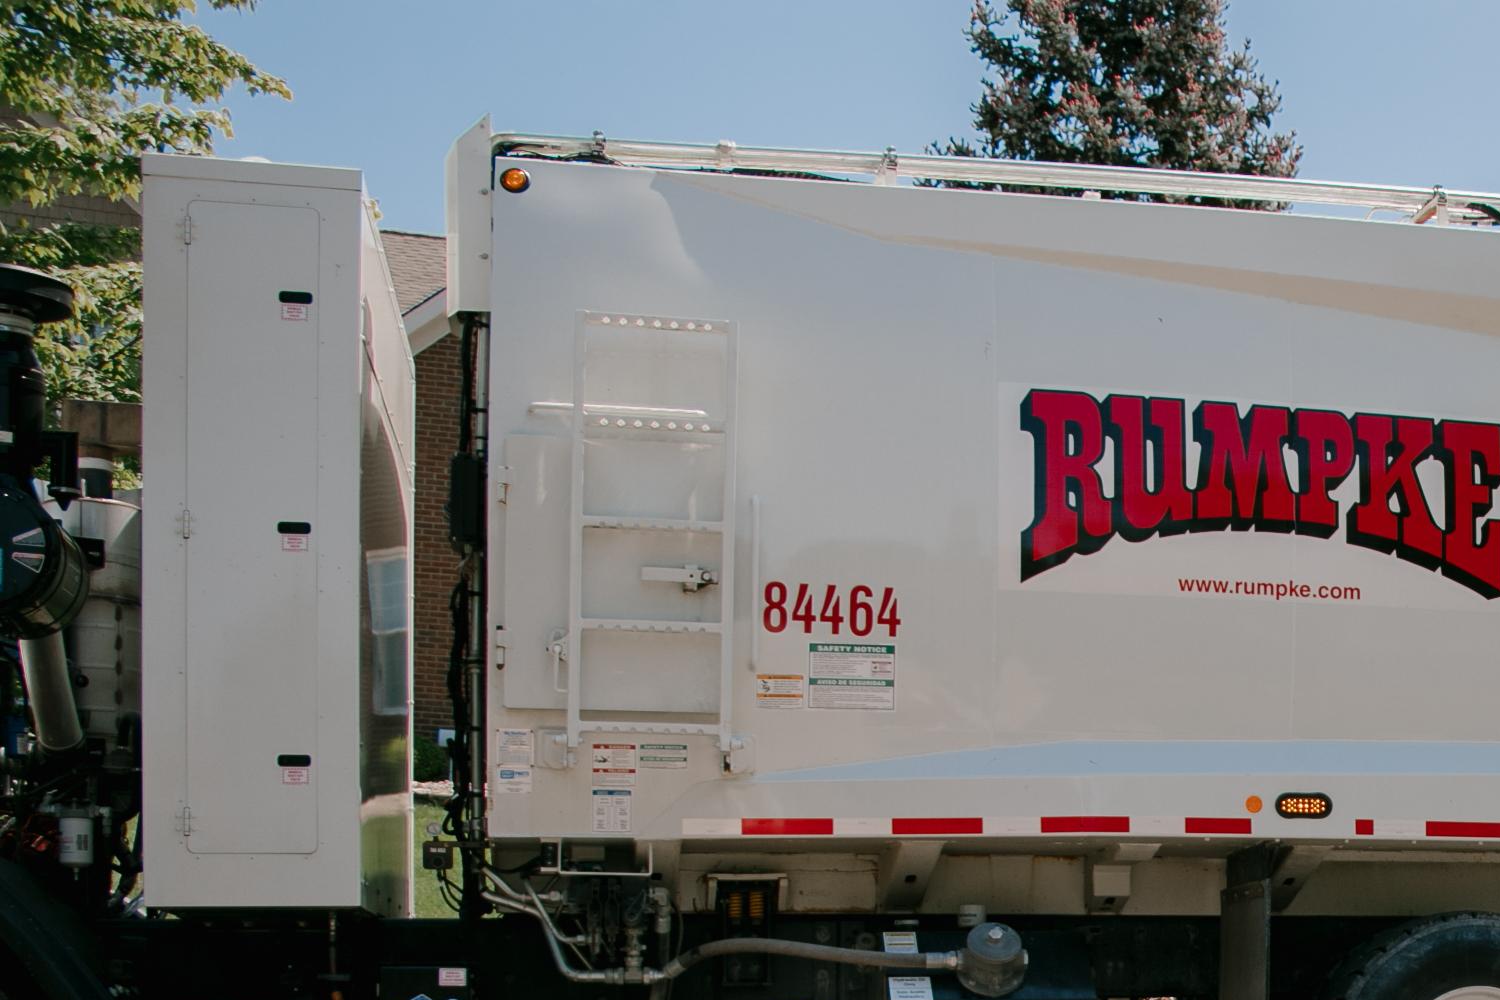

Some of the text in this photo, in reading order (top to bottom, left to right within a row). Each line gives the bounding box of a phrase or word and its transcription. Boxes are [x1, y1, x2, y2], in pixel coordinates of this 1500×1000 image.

[1178, 578, 1361, 600] www.rumpke.com
[763, 581, 901, 637] 84464
[817, 644, 887, 654] SAFETY NOTICE
